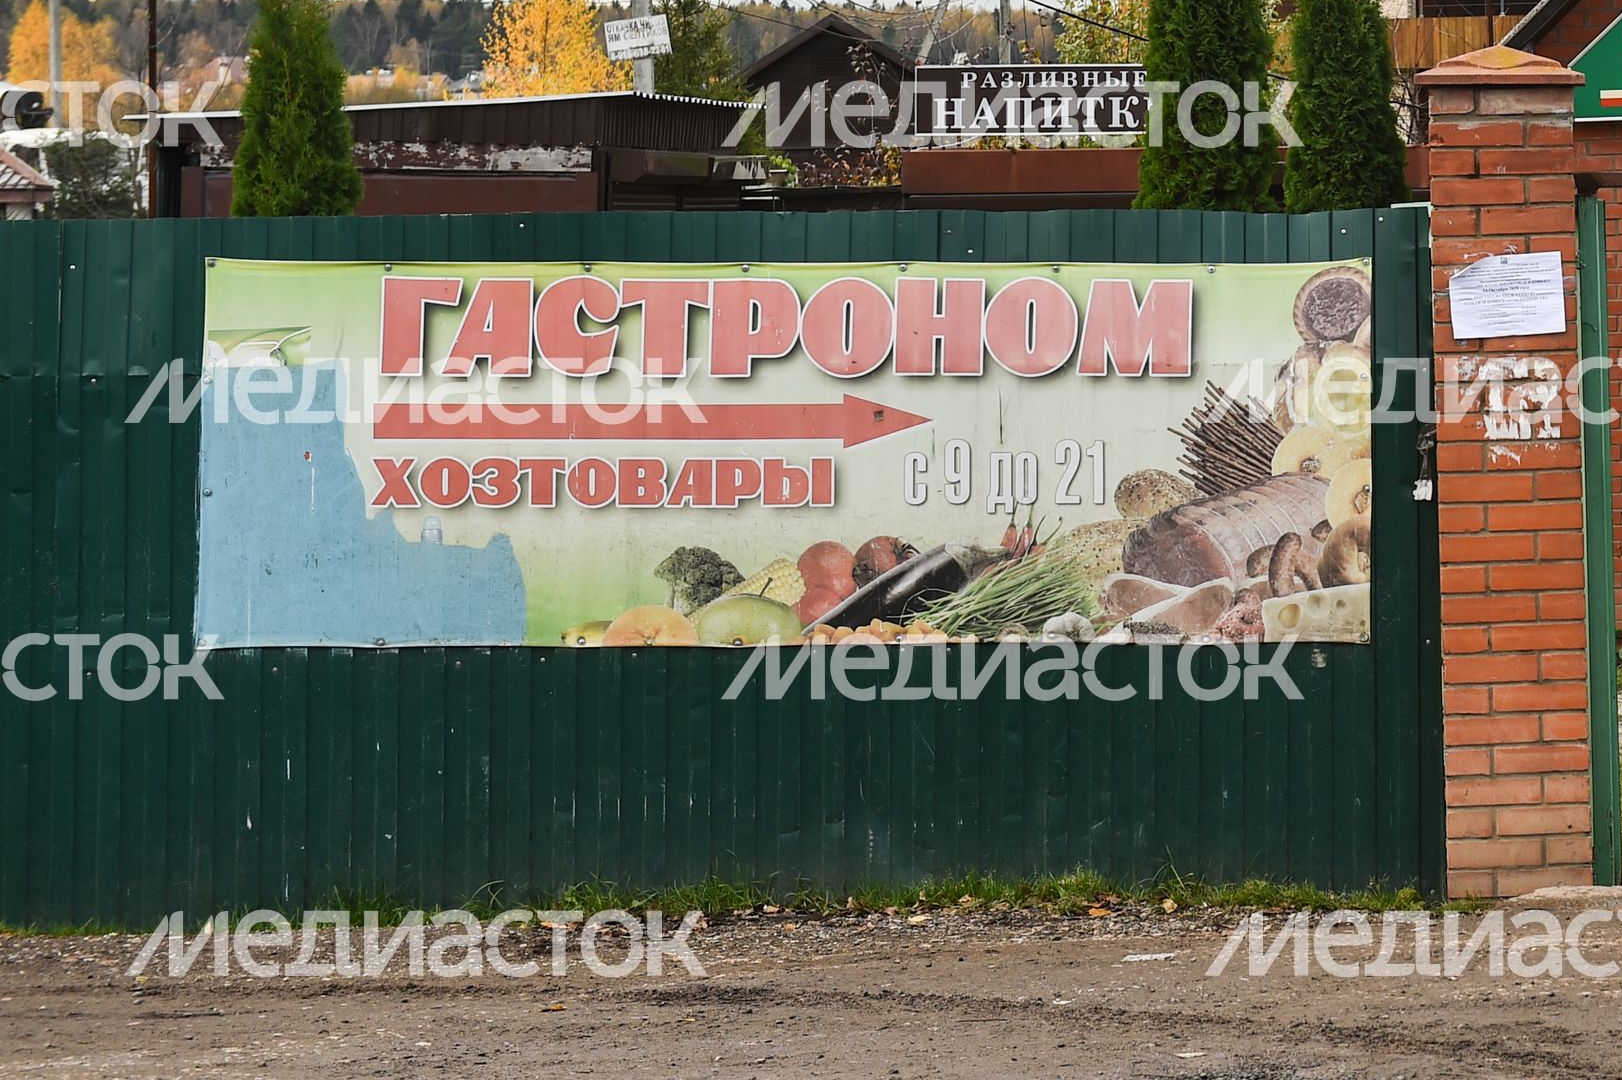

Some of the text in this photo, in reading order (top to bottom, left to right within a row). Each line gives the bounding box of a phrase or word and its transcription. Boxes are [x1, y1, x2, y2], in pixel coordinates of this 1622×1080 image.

[608, 26, 667, 42] ЯМ СЕПТИКОВ
[960, 70, 1147, 89] РАЗЛИВНЫЕ
[379, 275, 1194, 379] ГАСТРОНОМ
[369, 455, 836, 509] ХОЗТОВАРЫ
[944, 438, 971, 505] 9
[986, 451, 1039, 514] до
[1054, 439, 1105, 505] 21
